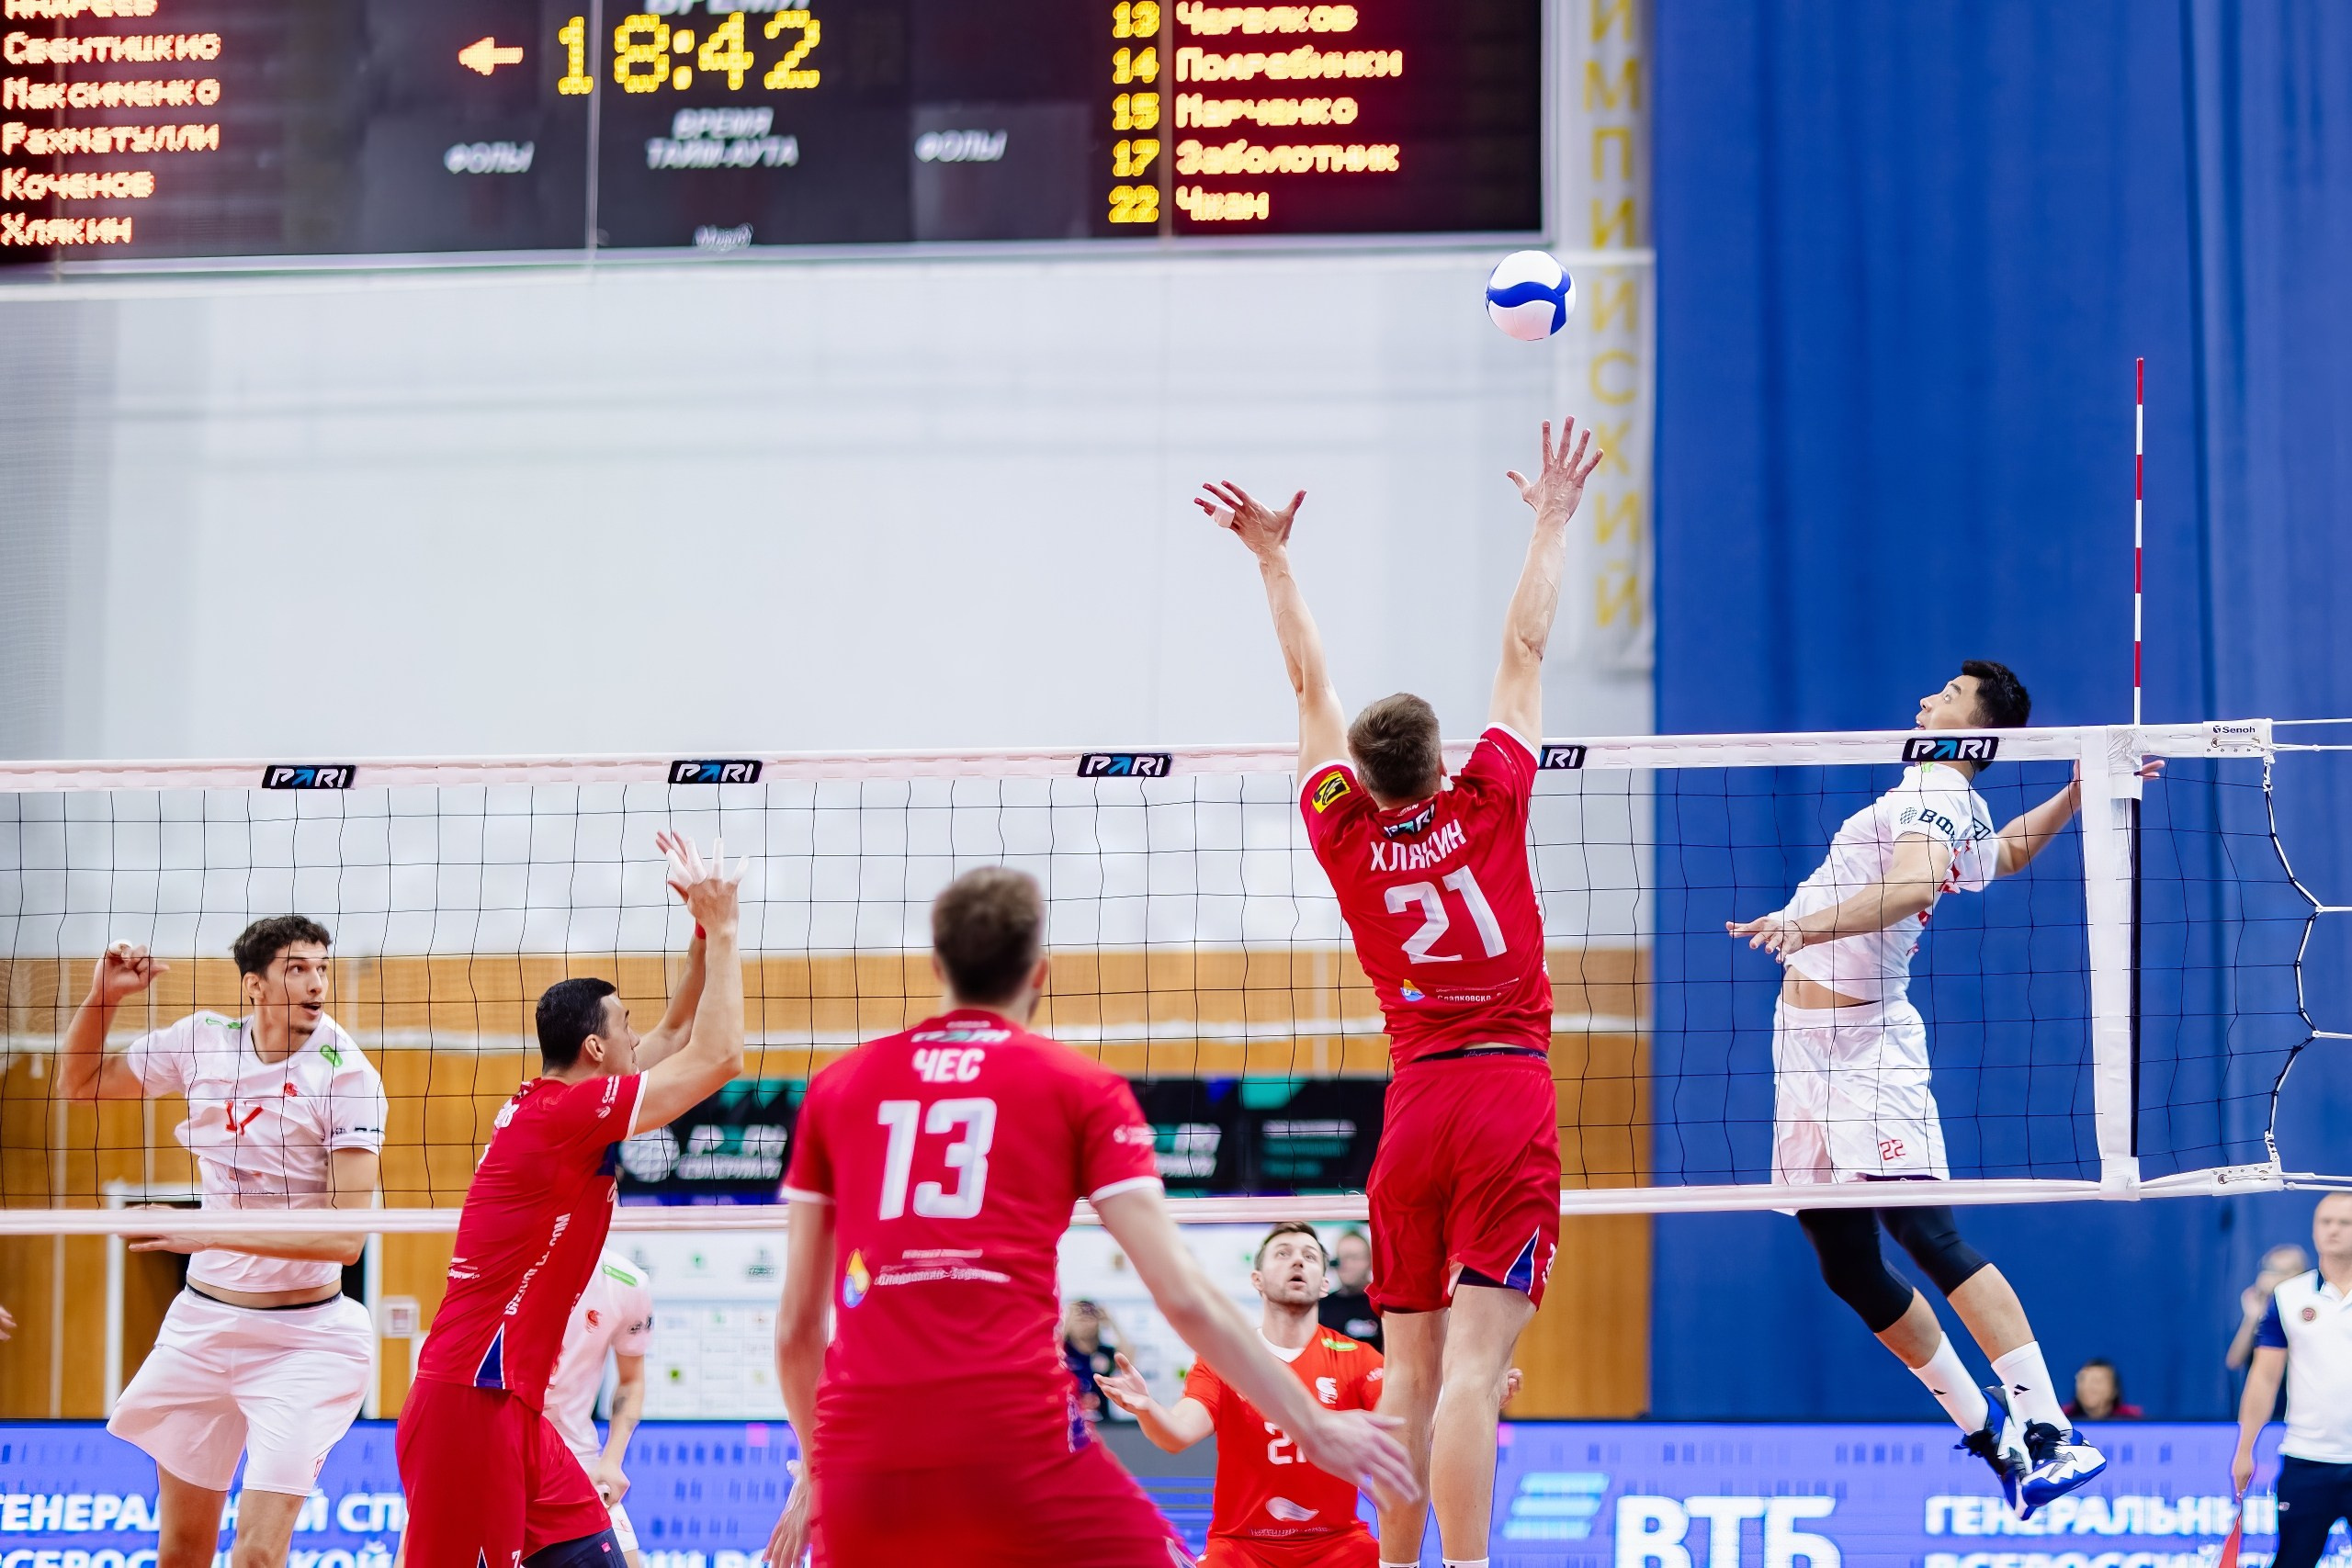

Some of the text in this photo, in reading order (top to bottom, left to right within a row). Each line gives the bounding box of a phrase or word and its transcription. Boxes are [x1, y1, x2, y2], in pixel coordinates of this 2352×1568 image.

[1113, 1, 1159, 38] 13
[558, 10, 820, 95] 18:42
[1113, 47, 1159, 84] 14
[1113, 93, 1159, 130] 15
[1113, 140, 1159, 176] 17
[1109, 186, 1159, 222] 22
[2222, 726, 2256, 734] Senoh
[1085, 756, 1165, 776] PARI
[1911, 739, 1992, 759] PARI
[270, 768, 347, 788] PARI
[675, 762, 754, 782] PARI
[1370, 818, 1467, 872] ХЛЯКИН
[1384, 864, 1507, 964] 21
[911, 1048, 986, 1083] ЧЕС
[877, 1097, 998, 1221] 13
[1880, 1139, 1906, 1160] 22
[1615, 1495, 1841, 1568] ВТБ
